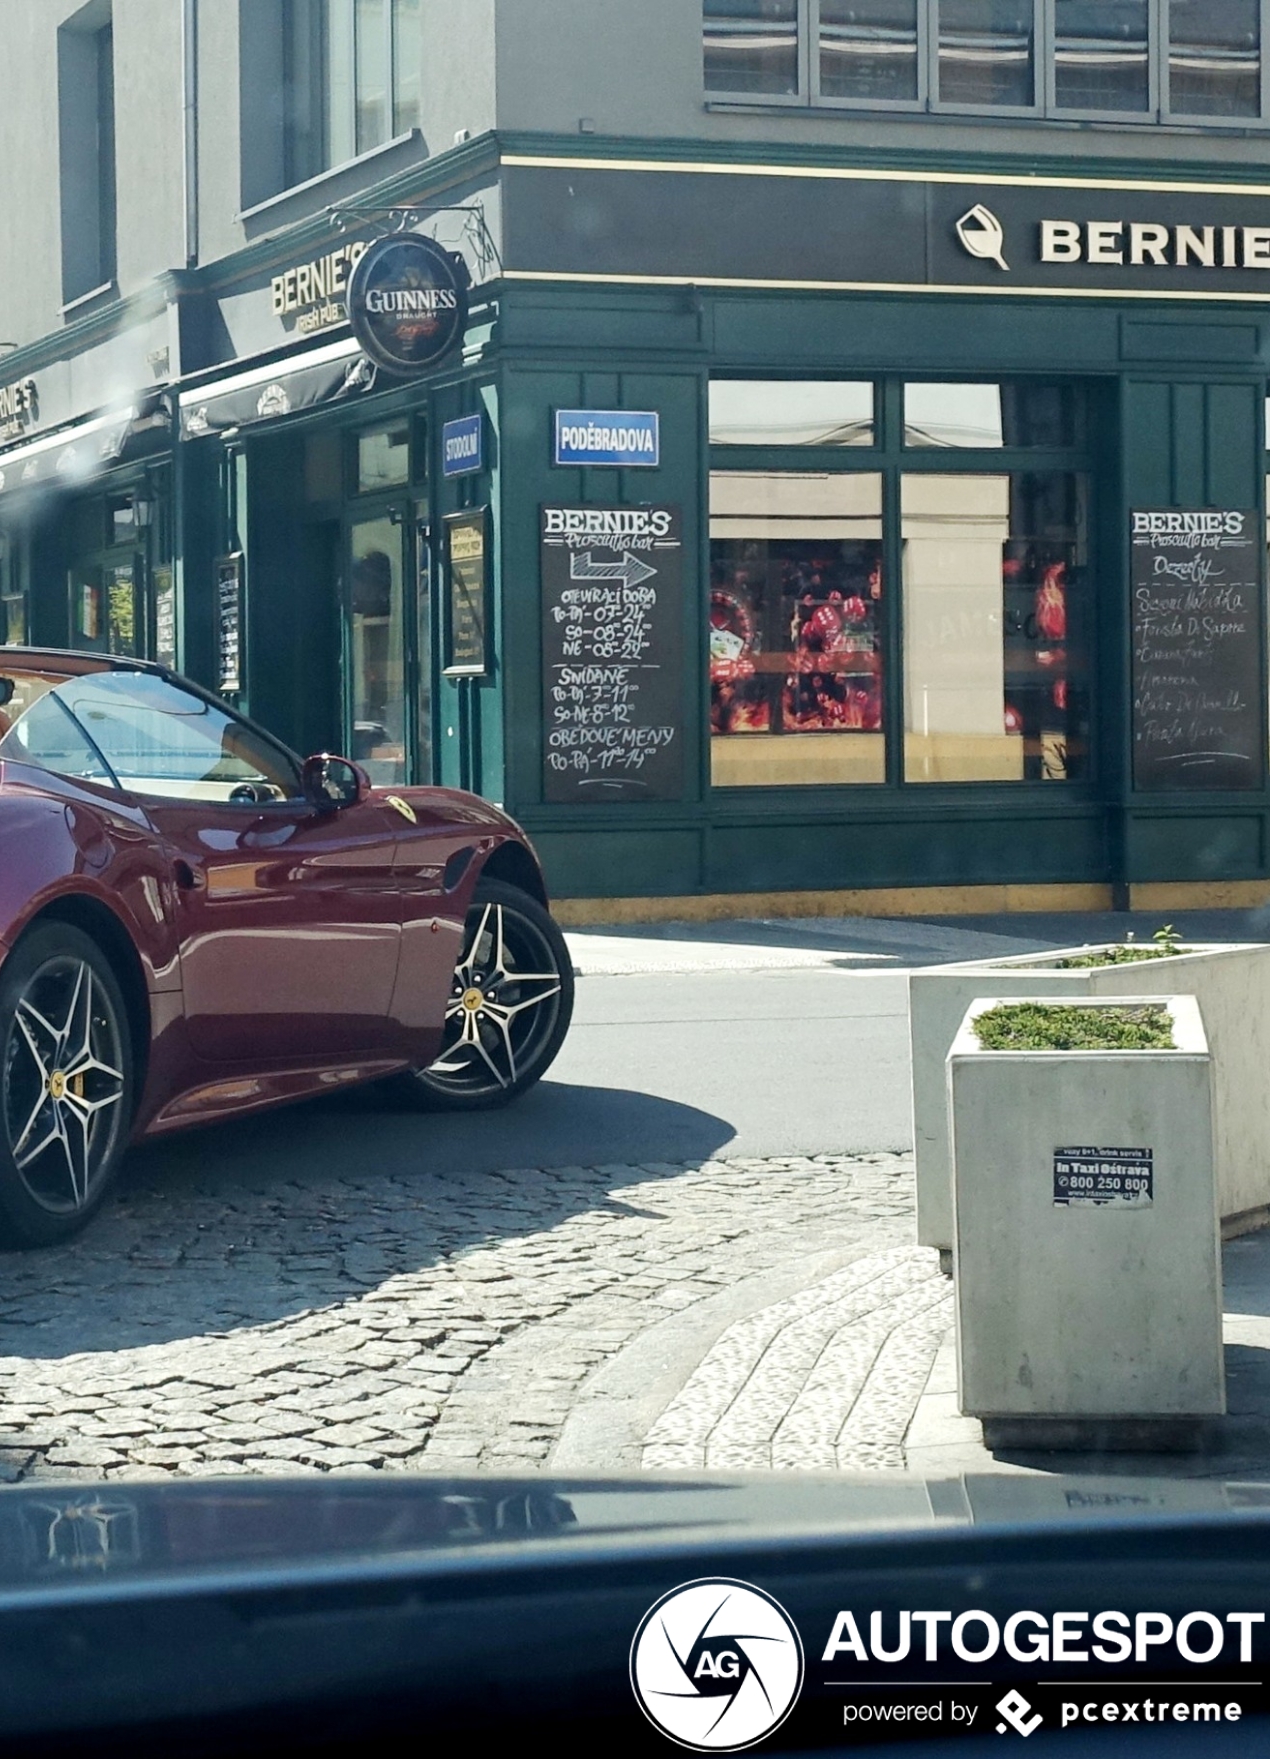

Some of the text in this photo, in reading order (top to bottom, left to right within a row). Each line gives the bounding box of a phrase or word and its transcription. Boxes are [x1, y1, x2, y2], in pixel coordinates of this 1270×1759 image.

[1040, 219, 1270, 268] BERNIE
[365, 288, 457, 314] GUINNESS
[395, 311, 438, 320] DRAUGHT
[561, 421, 654, 452] PODĚBRADOVA
[544, 509, 672, 536] BERNIE'S
[1132, 511, 1246, 534] BERNIE'S
[1056, 1162, 1150, 1176] In Taxi Ostrava
[1070, 1176, 1149, 1191] 800 250 800
